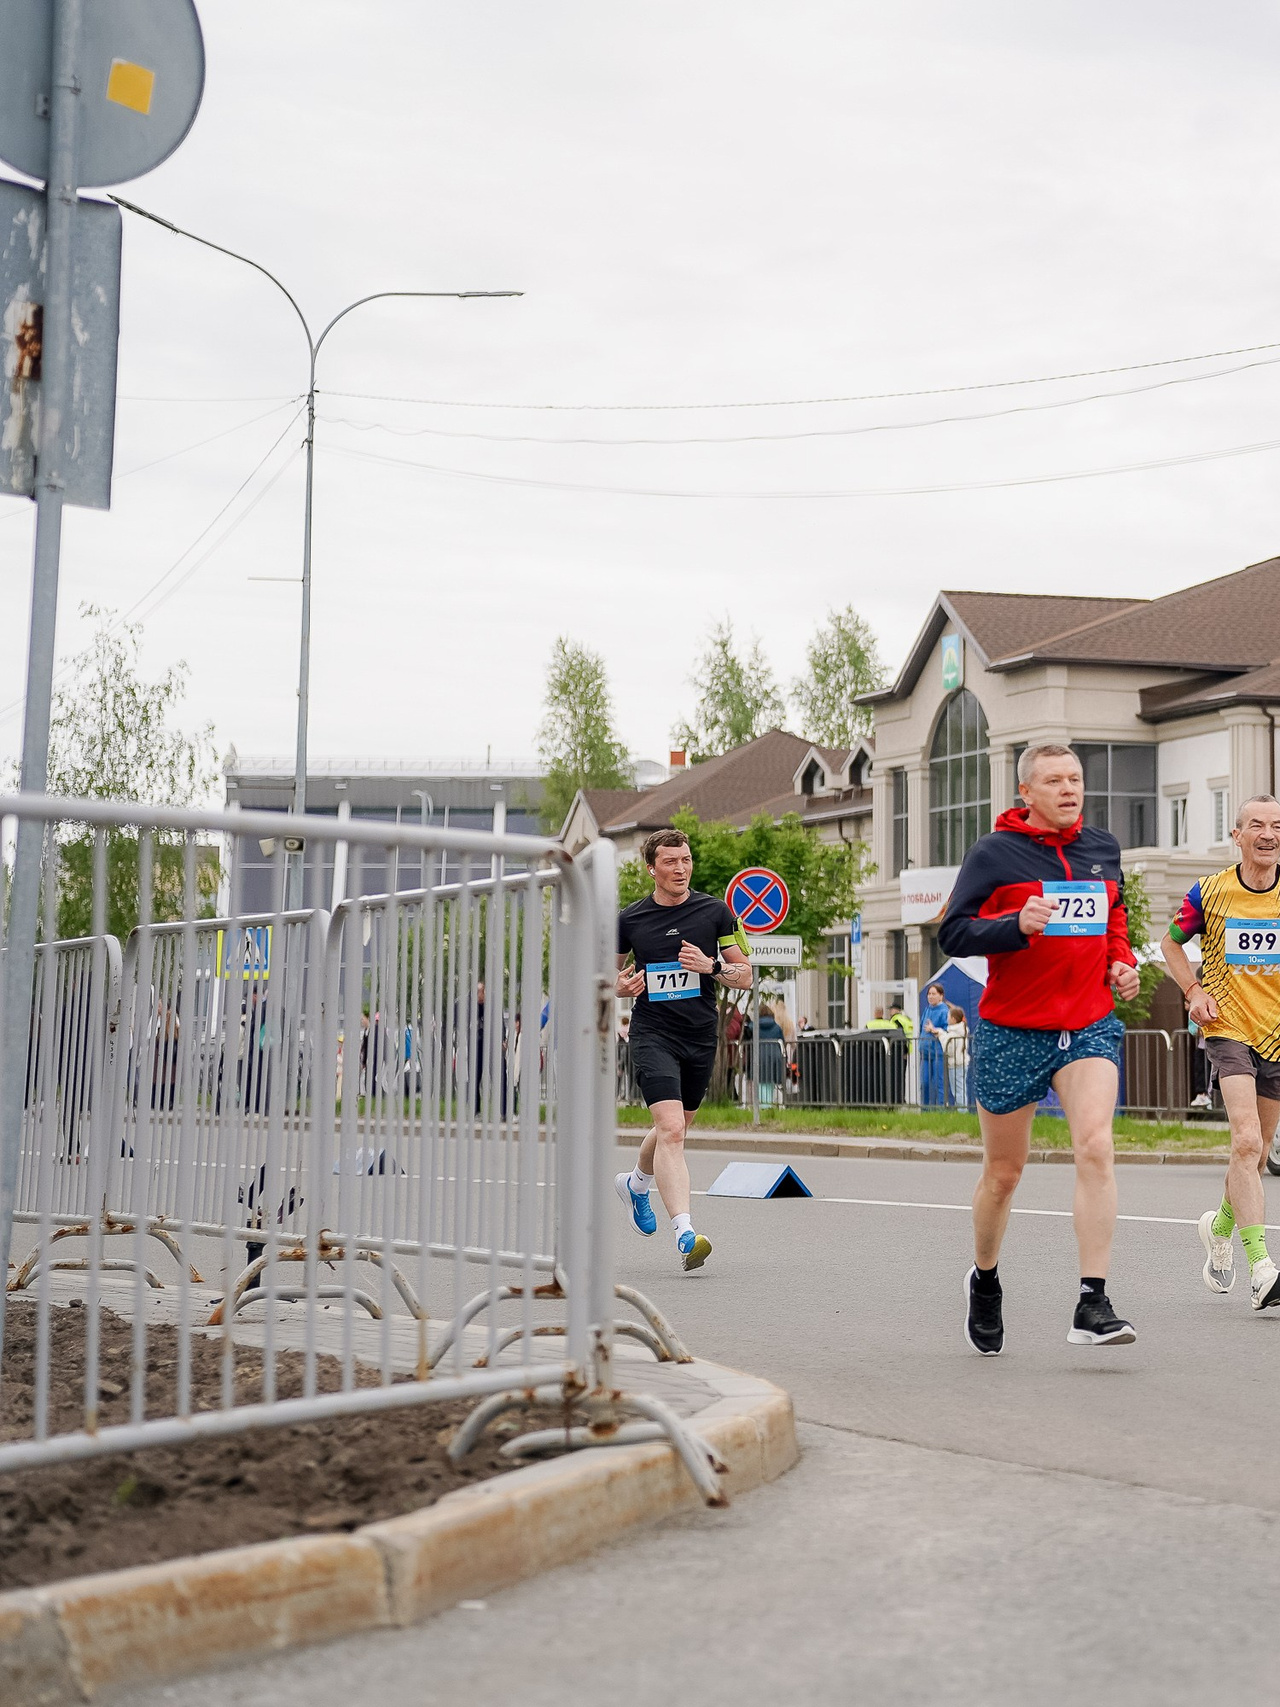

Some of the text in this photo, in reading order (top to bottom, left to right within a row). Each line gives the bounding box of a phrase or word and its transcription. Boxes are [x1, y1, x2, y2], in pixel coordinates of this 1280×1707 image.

[1058, 897, 1096, 919] 723
[1238, 932, 1277, 951] 899
[1248, 955, 1266, 963] 10км
[656, 972, 689, 989] 717
